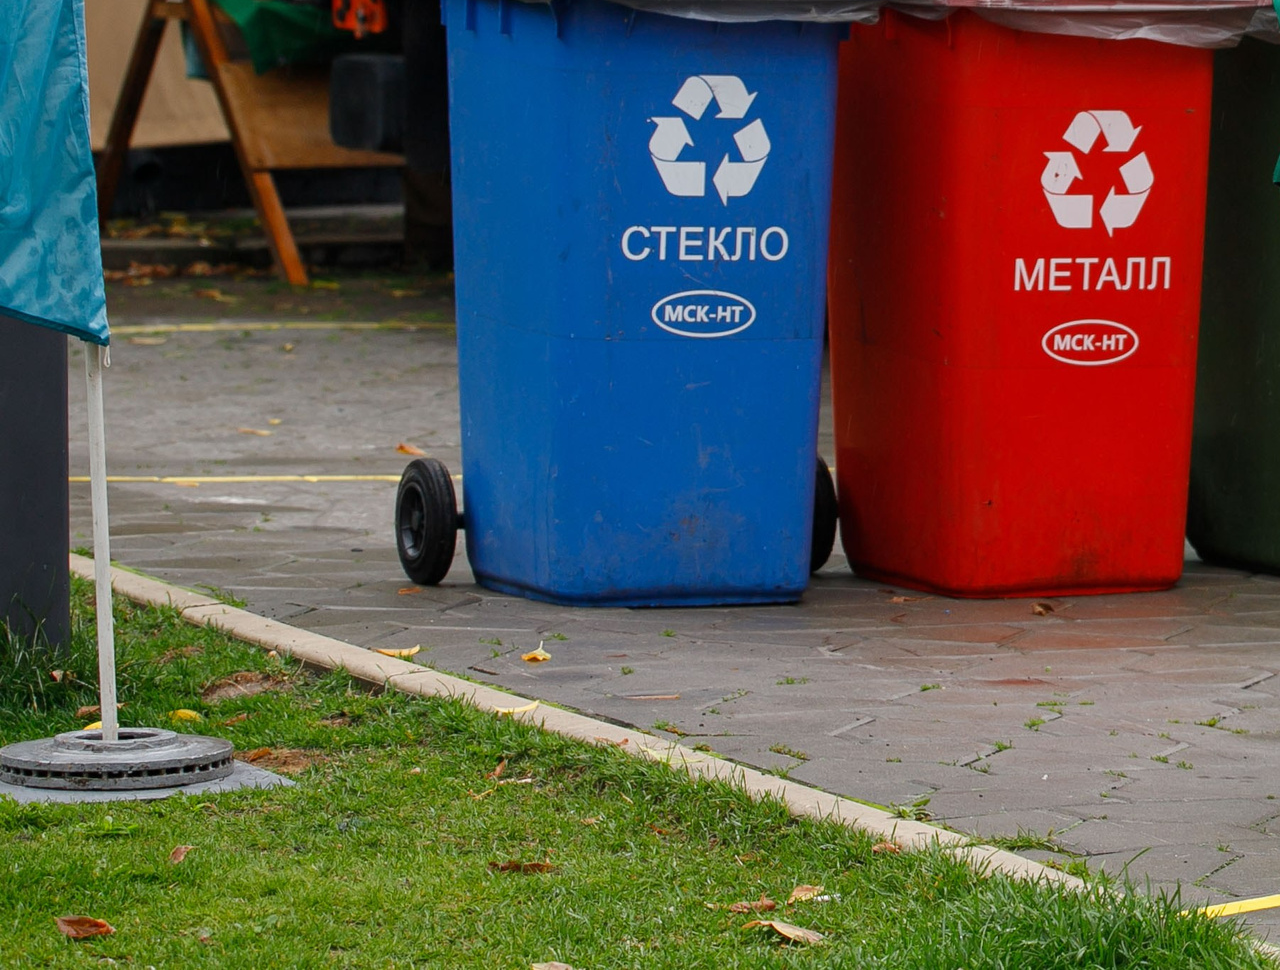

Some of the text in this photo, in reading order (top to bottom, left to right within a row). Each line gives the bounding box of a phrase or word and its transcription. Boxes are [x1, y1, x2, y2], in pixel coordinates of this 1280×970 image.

[621, 225, 789, 262] СТЕКЛО
[1013, 256, 1171, 292] МЕТАЛЛ
[664, 305, 744, 323] МСК-НТ
[1053, 333, 1127, 351] МСК-НТ
